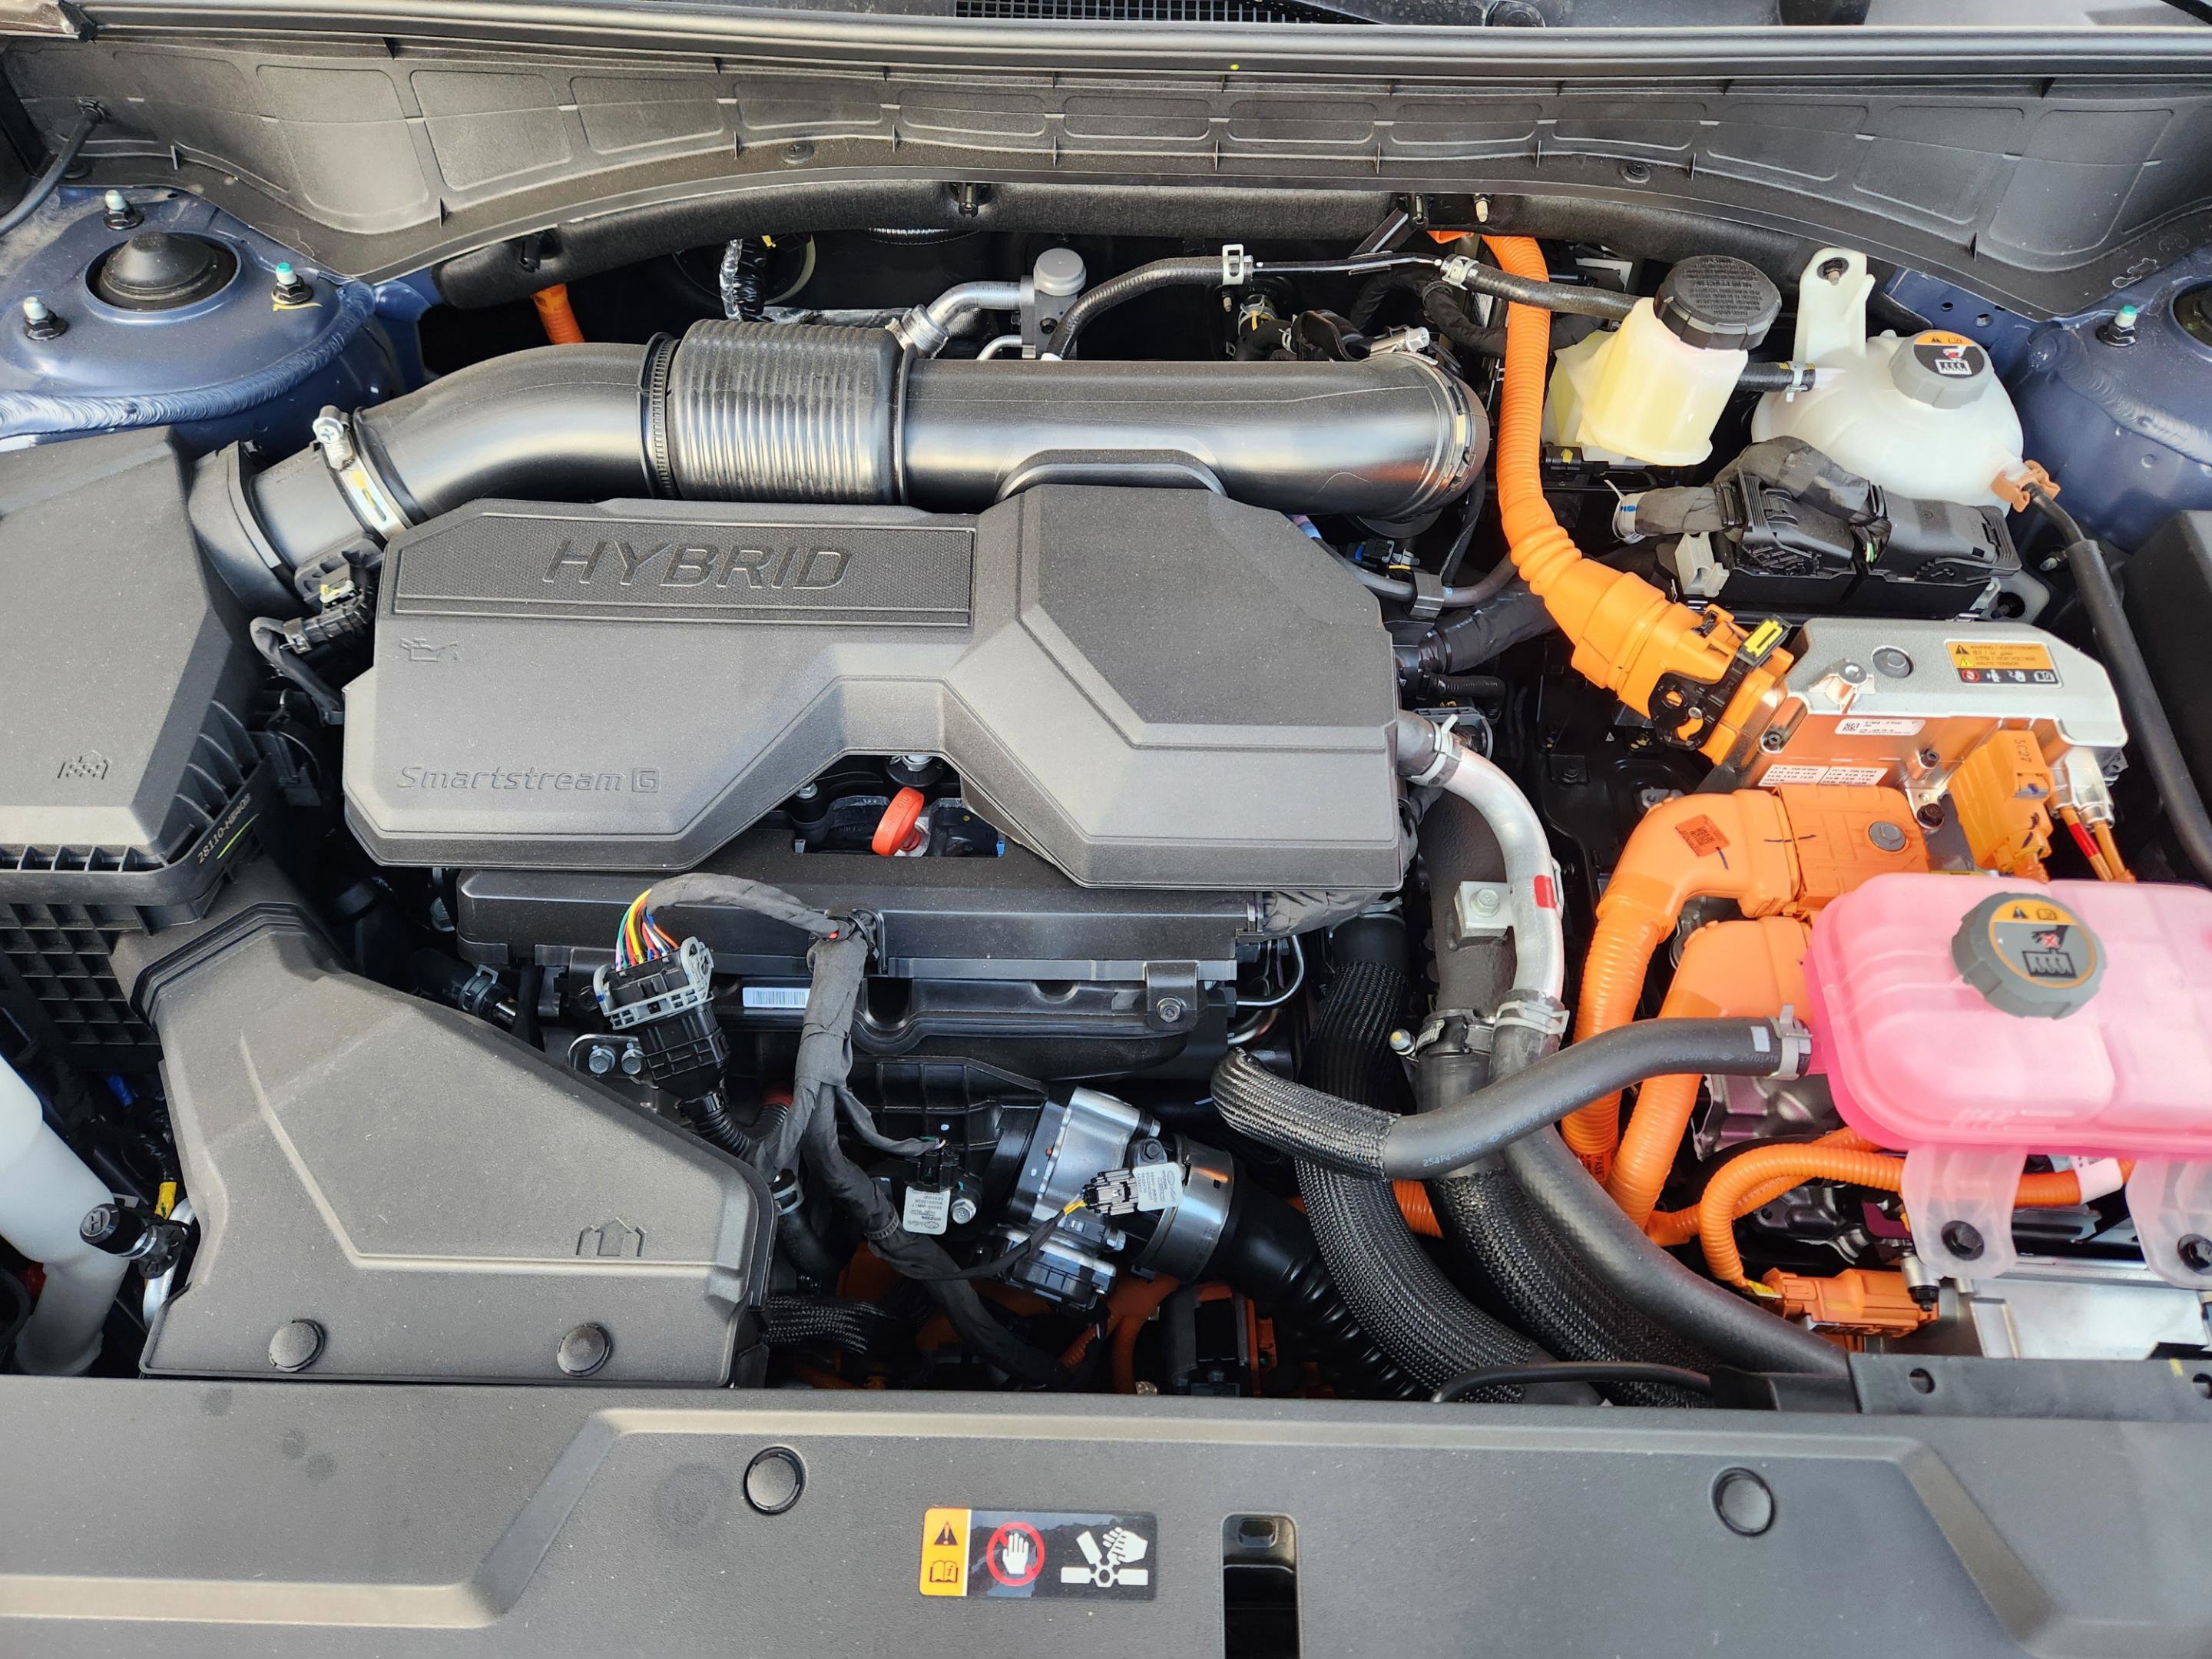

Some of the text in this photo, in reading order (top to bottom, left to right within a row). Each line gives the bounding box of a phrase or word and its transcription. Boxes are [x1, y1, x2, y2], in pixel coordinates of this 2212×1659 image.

[542, 538, 852, 590] HYBRID
[396, 767, 659, 792] Smartstream G
